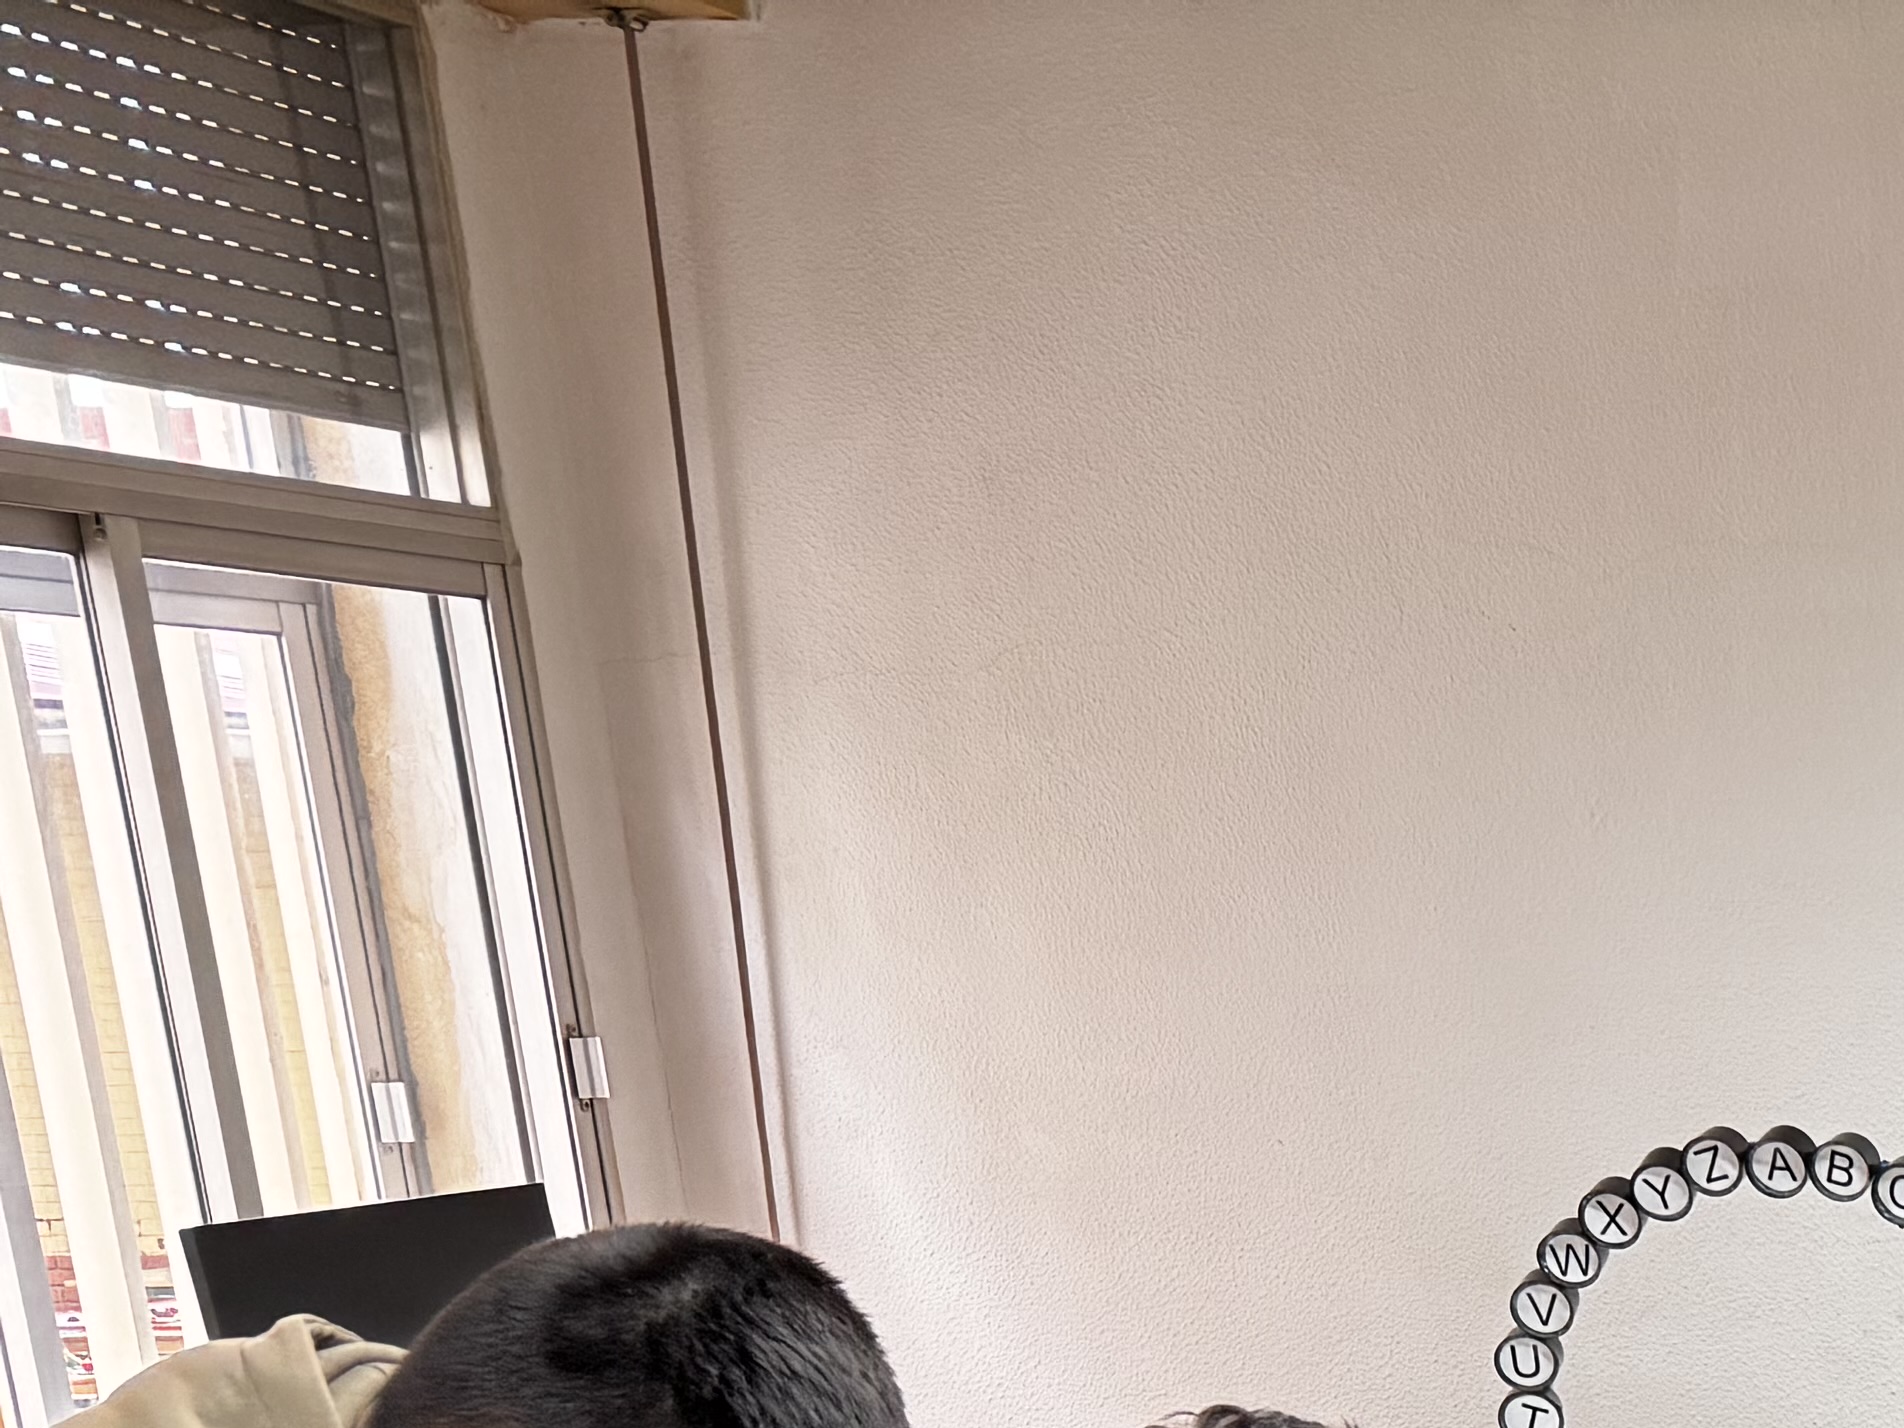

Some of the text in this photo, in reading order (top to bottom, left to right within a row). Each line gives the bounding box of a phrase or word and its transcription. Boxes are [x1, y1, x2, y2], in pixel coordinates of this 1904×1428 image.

[1693, 1144, 1730, 1185] Z
[1767, 1146, 1798, 1182] A
[1826, 1148, 1855, 1188] B
[1641, 1173, 1672, 1210] Y
[1594, 1199, 1628, 1236] X
[1549, 1243, 1590, 1277] W
[1526, 1292, 1558, 1327] V
[1509, 1344, 1541, 1379] U
